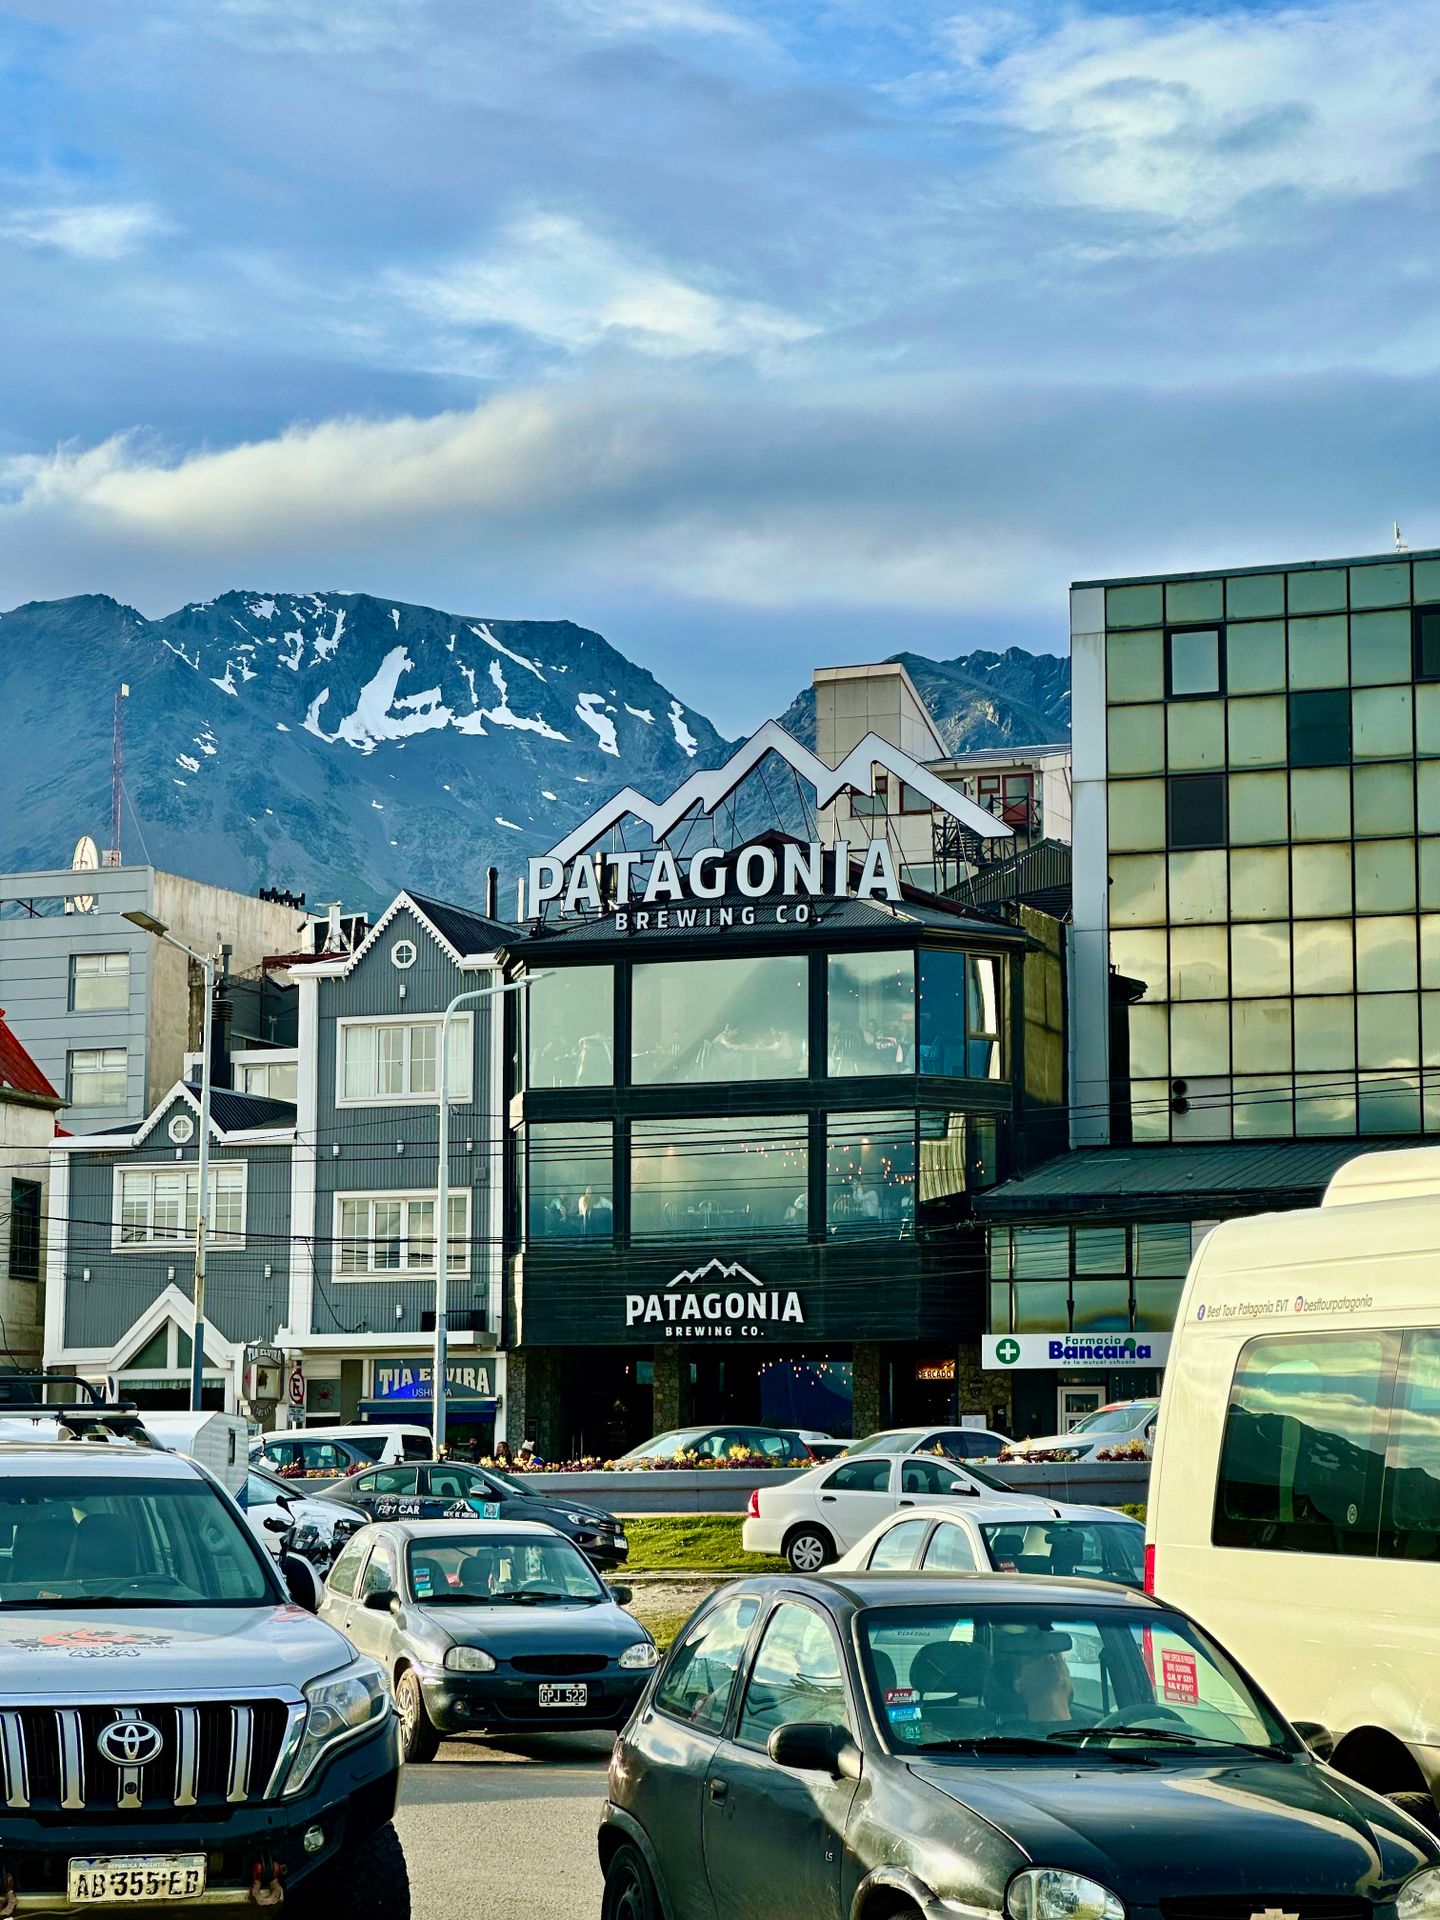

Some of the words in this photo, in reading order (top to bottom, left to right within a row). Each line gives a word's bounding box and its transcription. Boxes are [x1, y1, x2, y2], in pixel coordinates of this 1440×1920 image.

[527, 838, 904, 919] PATAGONIA
[615, 905, 756, 931] BREWING
[776, 904, 822, 923] CO.
[625, 1291, 804, 1326] PATAGONIA
[1207, 1305, 1222, 1318] Best
[1223, 1304, 1237, 1317] Tour
[1238, 1300, 1274, 1317] Patagonia
[1275, 1299, 1289, 1313] EVT
[665, 1326, 732, 1336] BREWING
[741, 1326, 764, 1336] CO.
[1065, 1335, 1121, 1345] Farmacia
[1048, 1338, 1152, 1360] Bancaria
[379, 1368, 413, 1396] TIA
[419, 1367, 490, 1395] EVIRA
[398, 1505, 420, 1515] CAR
[541, 1689, 560, 1702] GPJ
[565, 1689, 585, 1702] 522
[114, 1871, 160, 1896] 355
